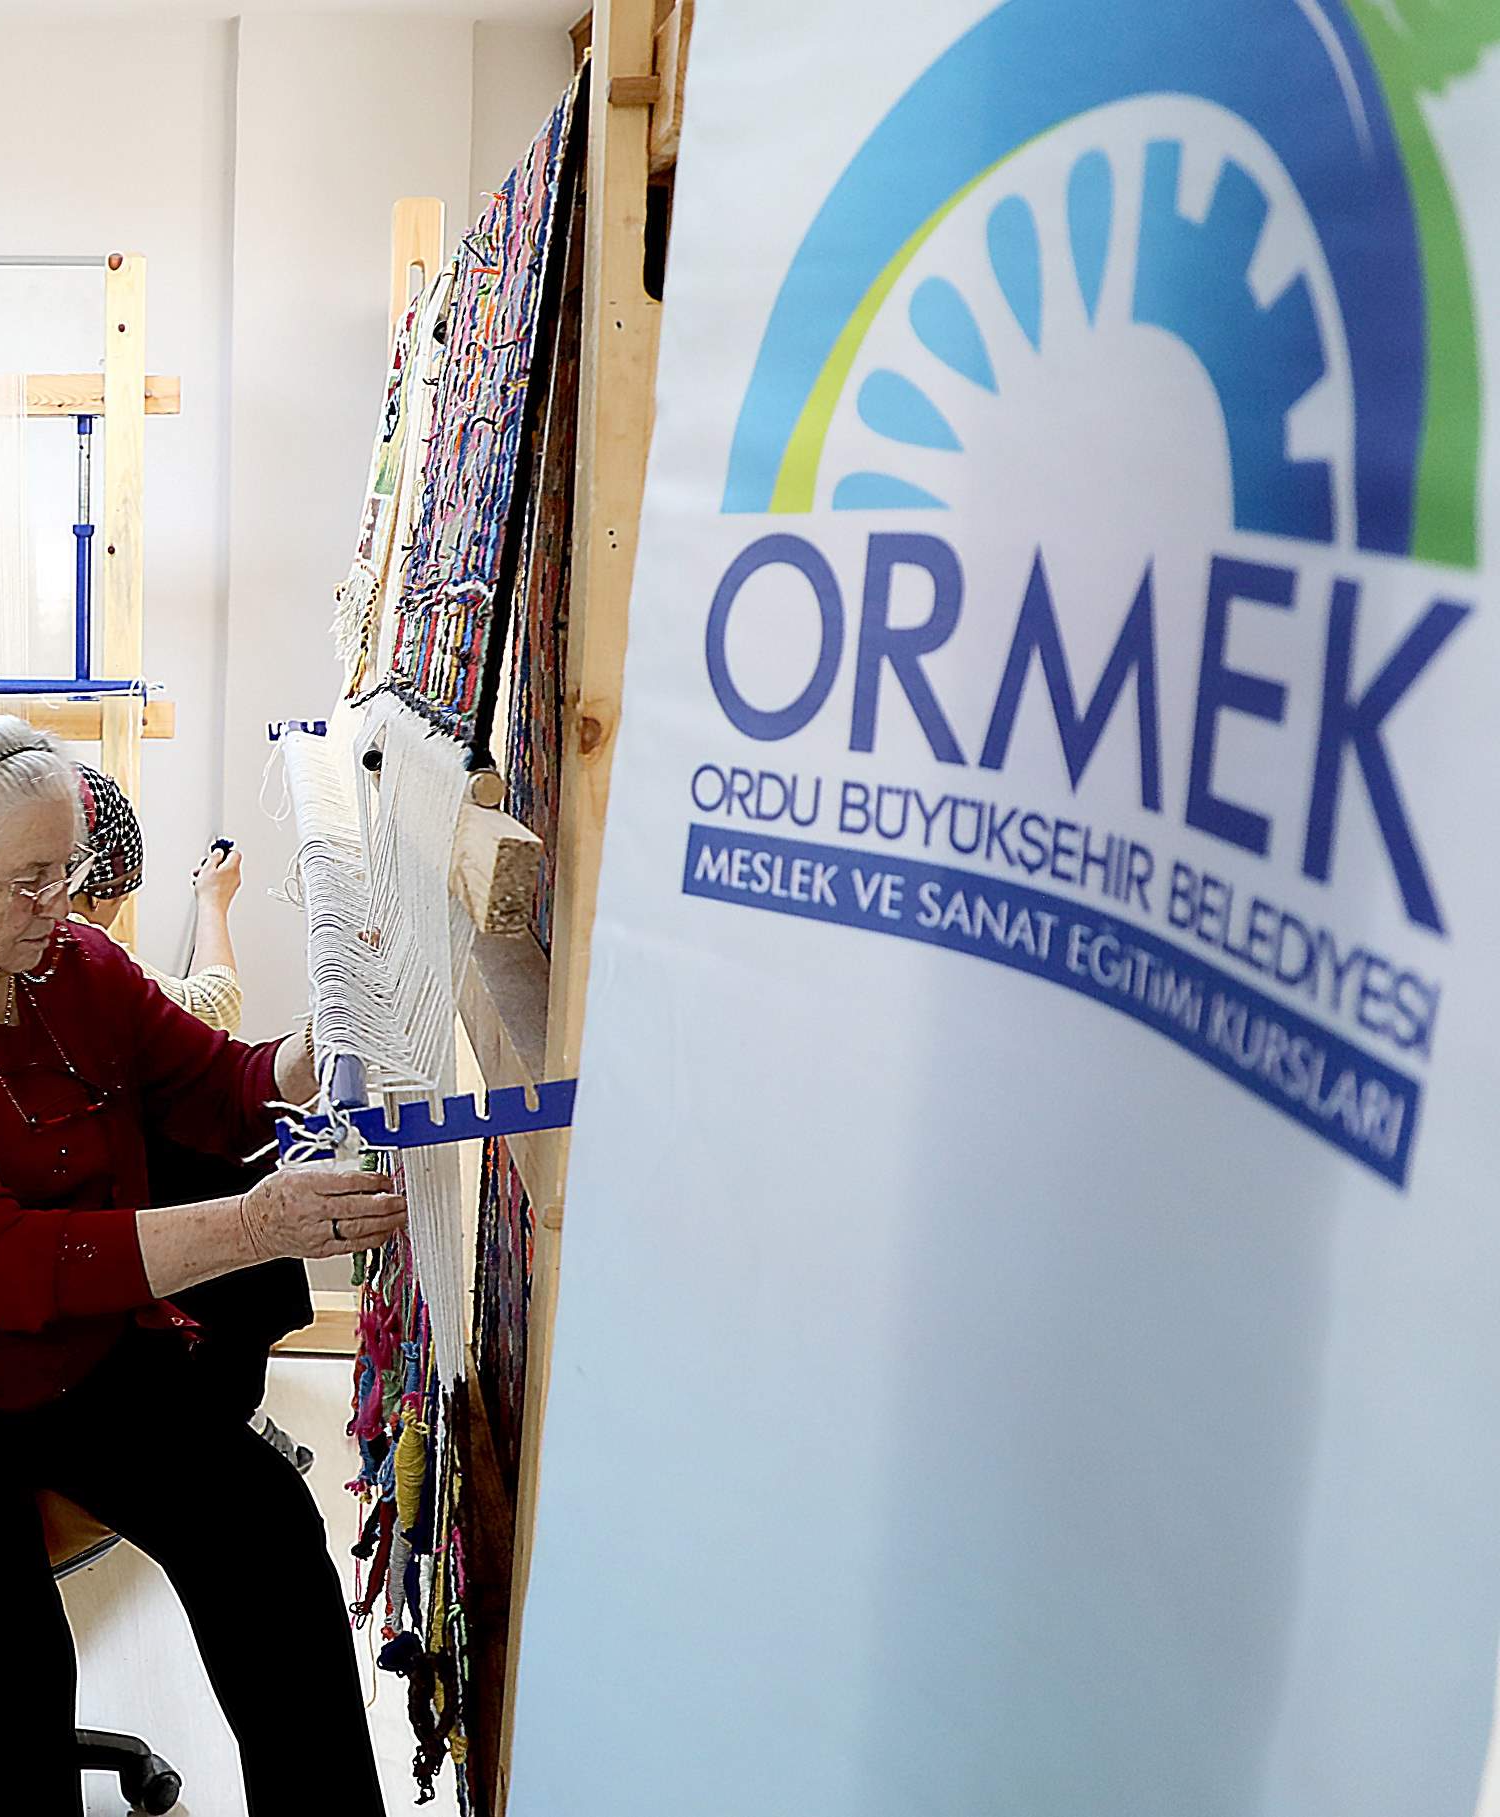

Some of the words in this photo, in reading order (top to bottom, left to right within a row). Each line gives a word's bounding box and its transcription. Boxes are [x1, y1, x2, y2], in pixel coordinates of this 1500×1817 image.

[691, 764, 822, 828] ORDU
[705, 532, 1476, 942] ORMEK
[694, 844, 838, 908] MESLEK
[851, 867, 906, 919] VE
[916, 881, 1060, 964] SANAT
[1206, 990, 1406, 1161] KURSLARI
